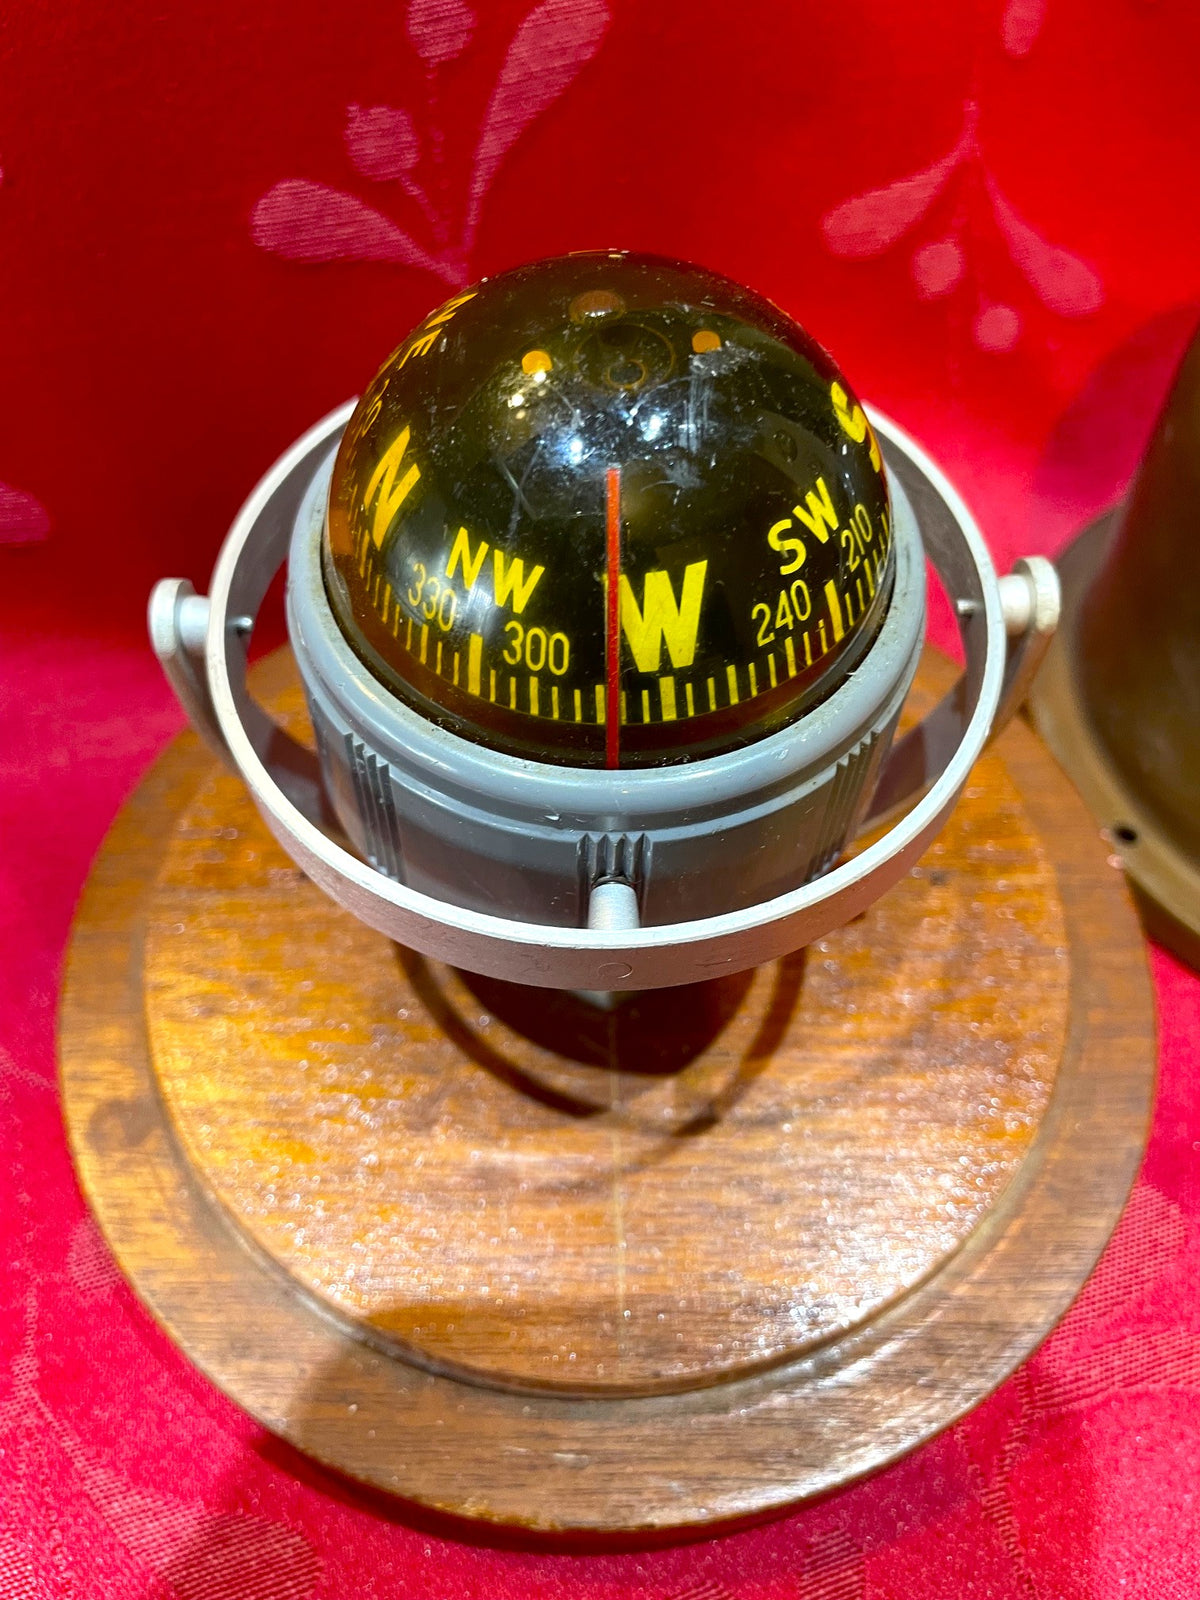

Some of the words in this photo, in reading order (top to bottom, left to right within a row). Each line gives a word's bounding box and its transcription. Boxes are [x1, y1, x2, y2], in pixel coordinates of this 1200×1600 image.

[364, 425, 421, 551] N
[768, 477, 839, 575] SW
[446, 527, 545, 615] NW
[841, 504, 873, 569] 210
[407, 563, 458, 633] 330
[603, 559, 708, 673] W
[751, 579, 811, 648] 240
[503, 620, 570, 676] 300
